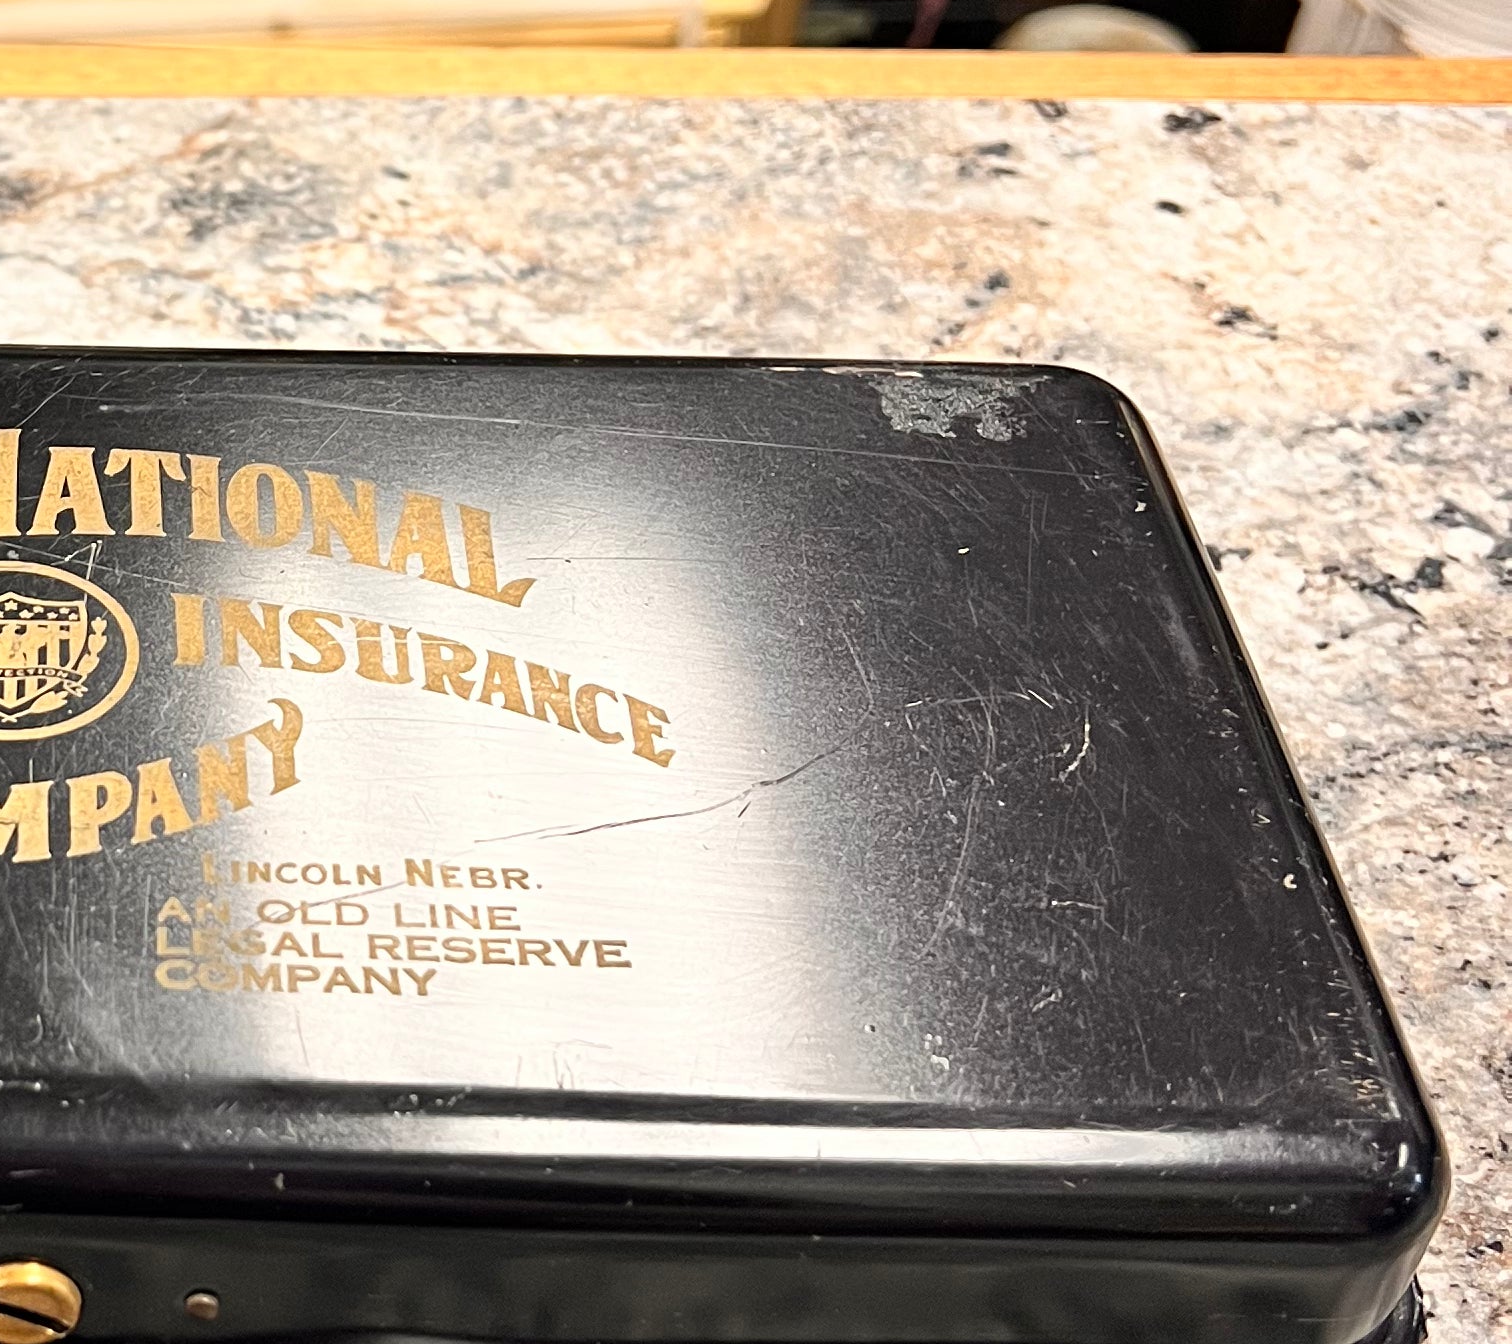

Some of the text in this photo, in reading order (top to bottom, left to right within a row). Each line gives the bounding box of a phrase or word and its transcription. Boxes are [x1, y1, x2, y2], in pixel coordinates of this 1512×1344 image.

[170, 591, 676, 768] INSURANCE
[201, 851, 544, 891] LINCOLN NEBR.
[156, 896, 522, 932] AN OLD LINE
[155, 925, 633, 969] LEGAL RESERVE
[154, 959, 438, 996] COMPANY
